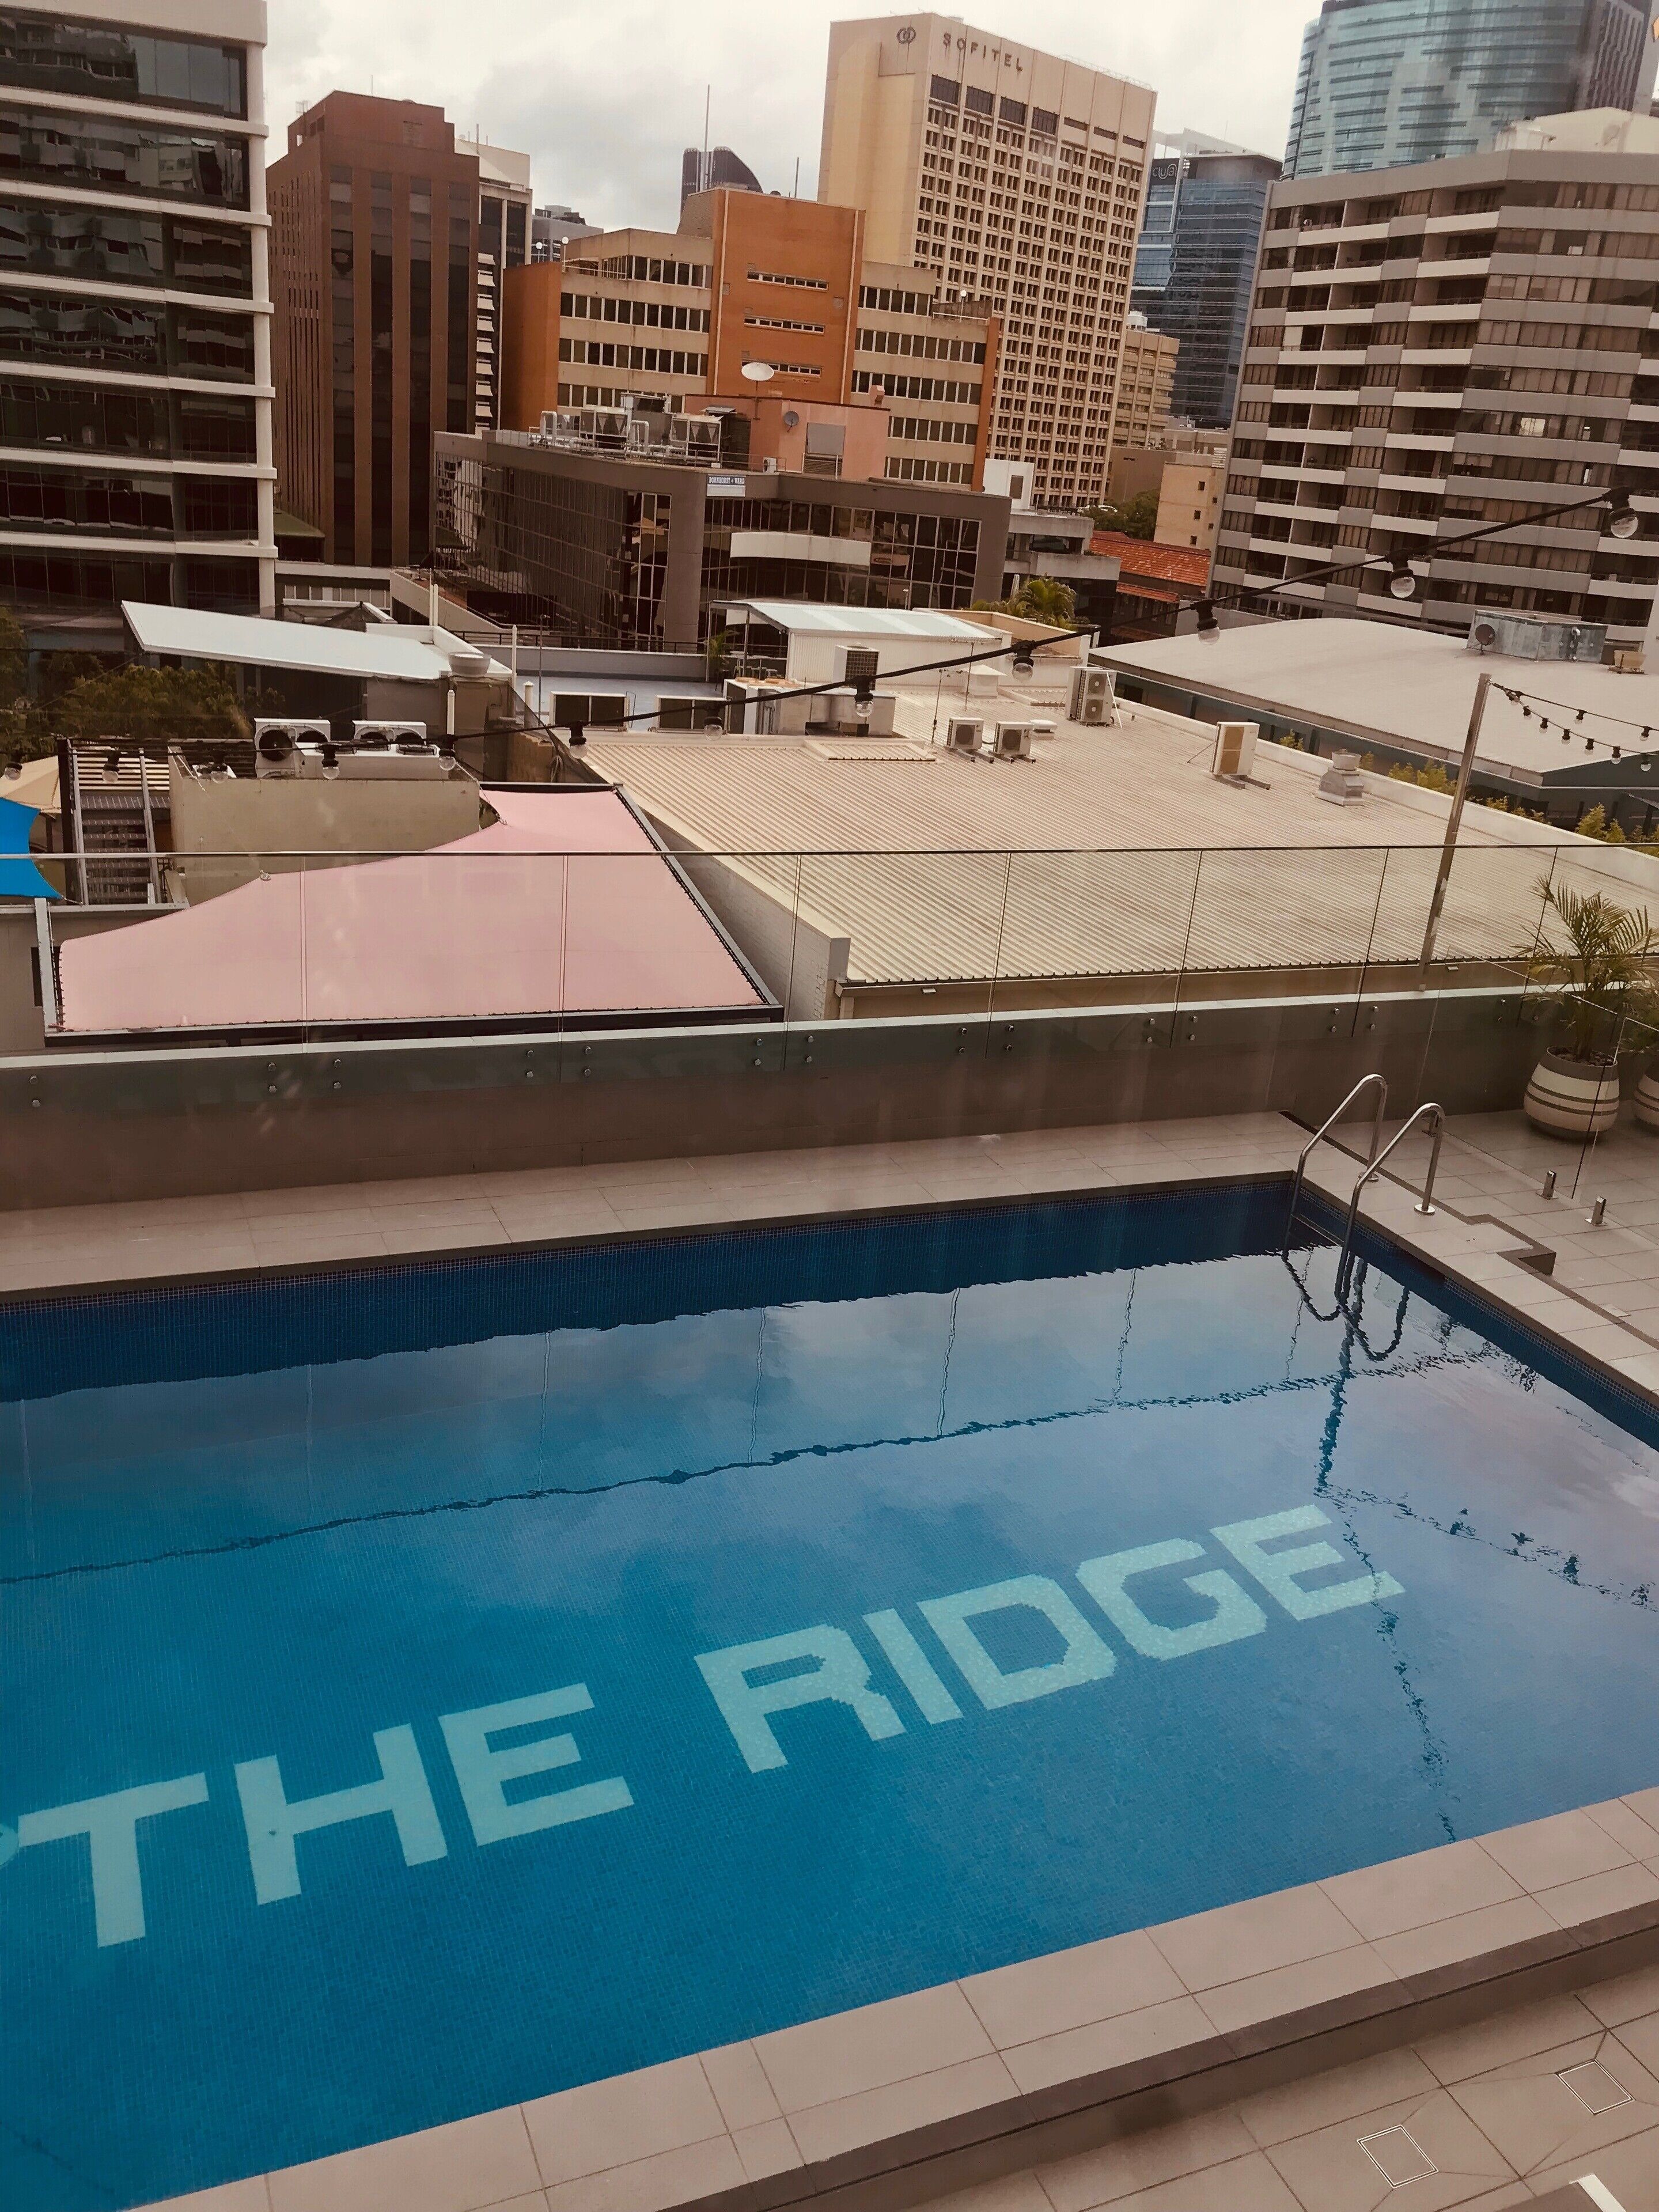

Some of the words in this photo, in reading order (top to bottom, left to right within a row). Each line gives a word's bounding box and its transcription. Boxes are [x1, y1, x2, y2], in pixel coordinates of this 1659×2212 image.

[943, 33, 1023, 72] SOFITEL
[18, 1682, 634, 1948] THE
[694, 1503, 1406, 1774] RIDGE
